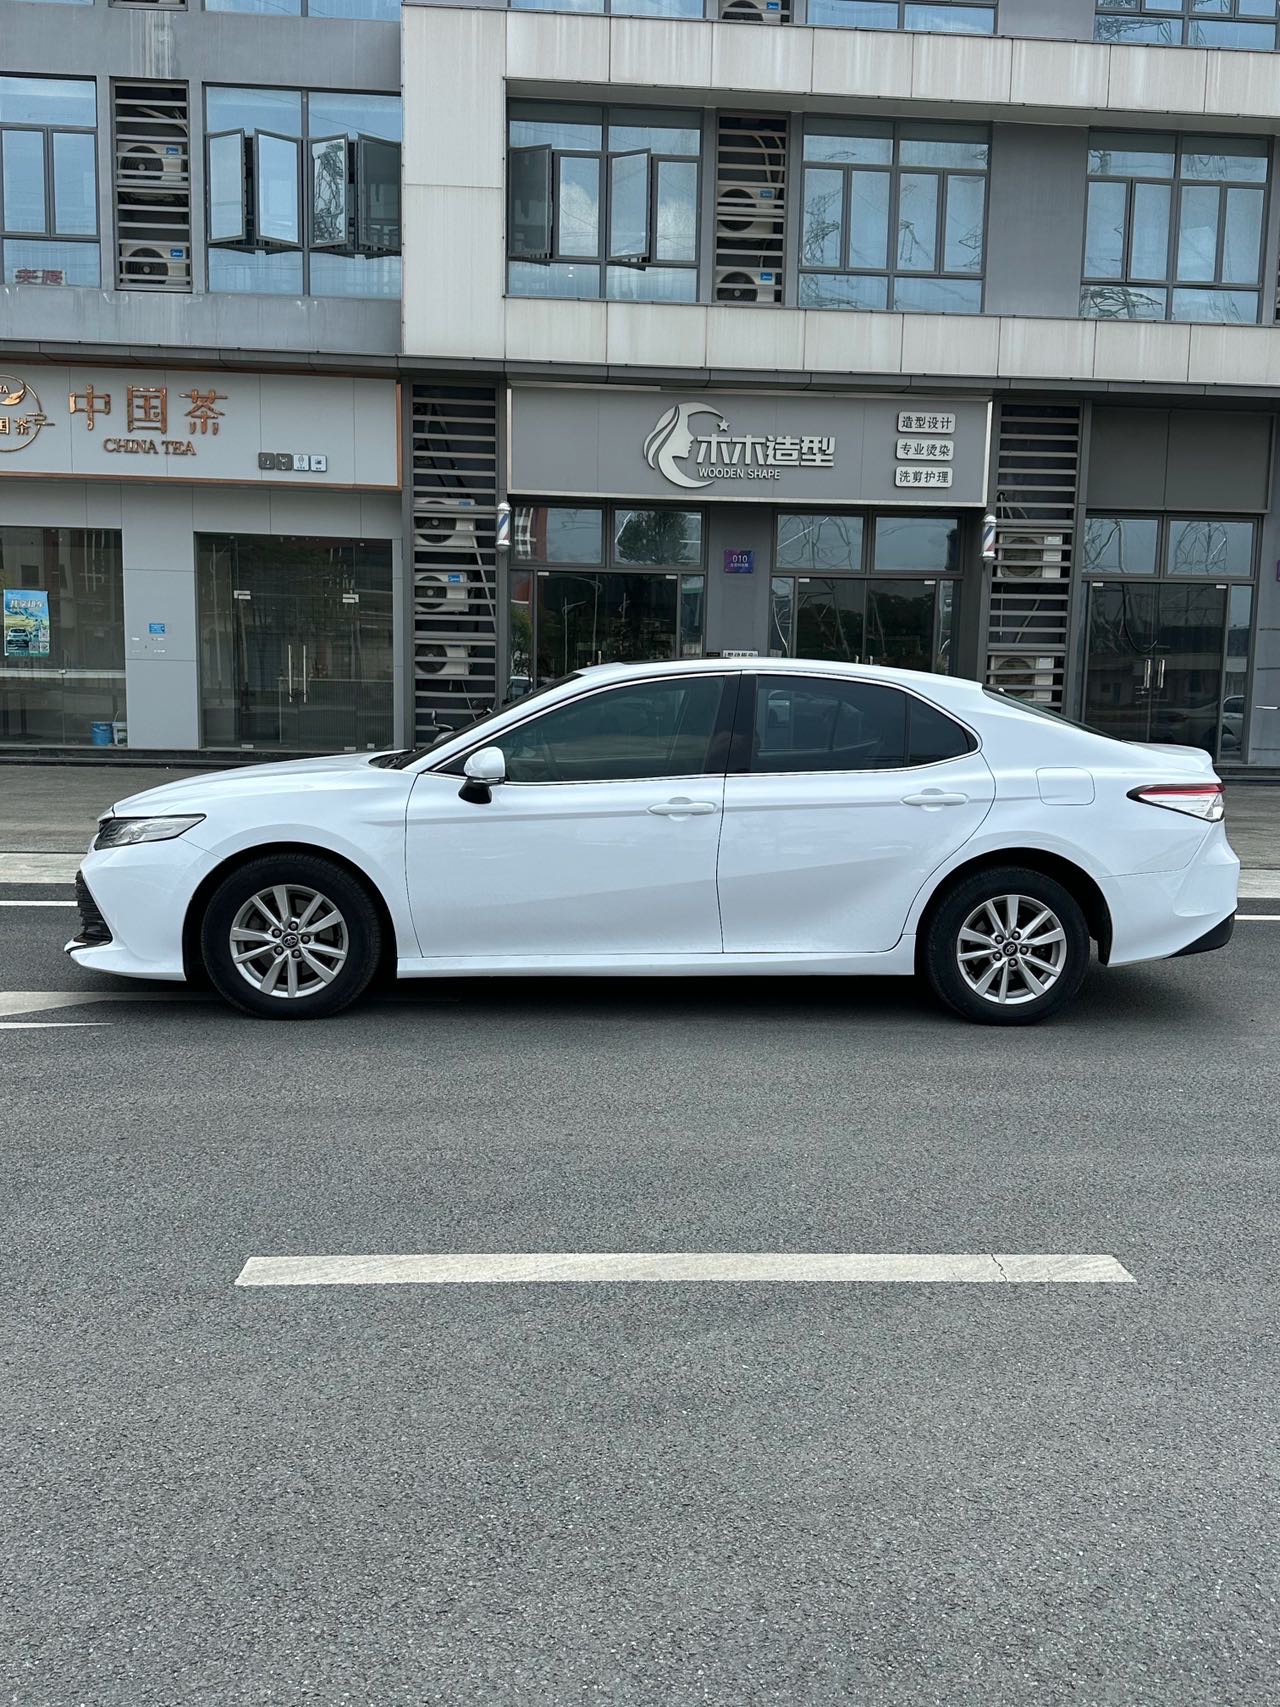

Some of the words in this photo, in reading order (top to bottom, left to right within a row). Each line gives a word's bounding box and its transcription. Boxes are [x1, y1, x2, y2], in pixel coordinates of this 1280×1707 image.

[68, 384, 228, 435] 中国茶
[901, 416, 952, 429] 造型设计
[103, 438, 159, 455] CHINA
[161, 440, 197, 456] TEA
[696, 434, 836, 467] 木木造型
[900, 442, 950, 456] 专业烫染
[698, 467, 744, 478] WOODEN
[747, 469, 781, 479] SHAPE
[899, 470, 949, 483] 洗剪护理
[732, 554, 748, 563] 010
